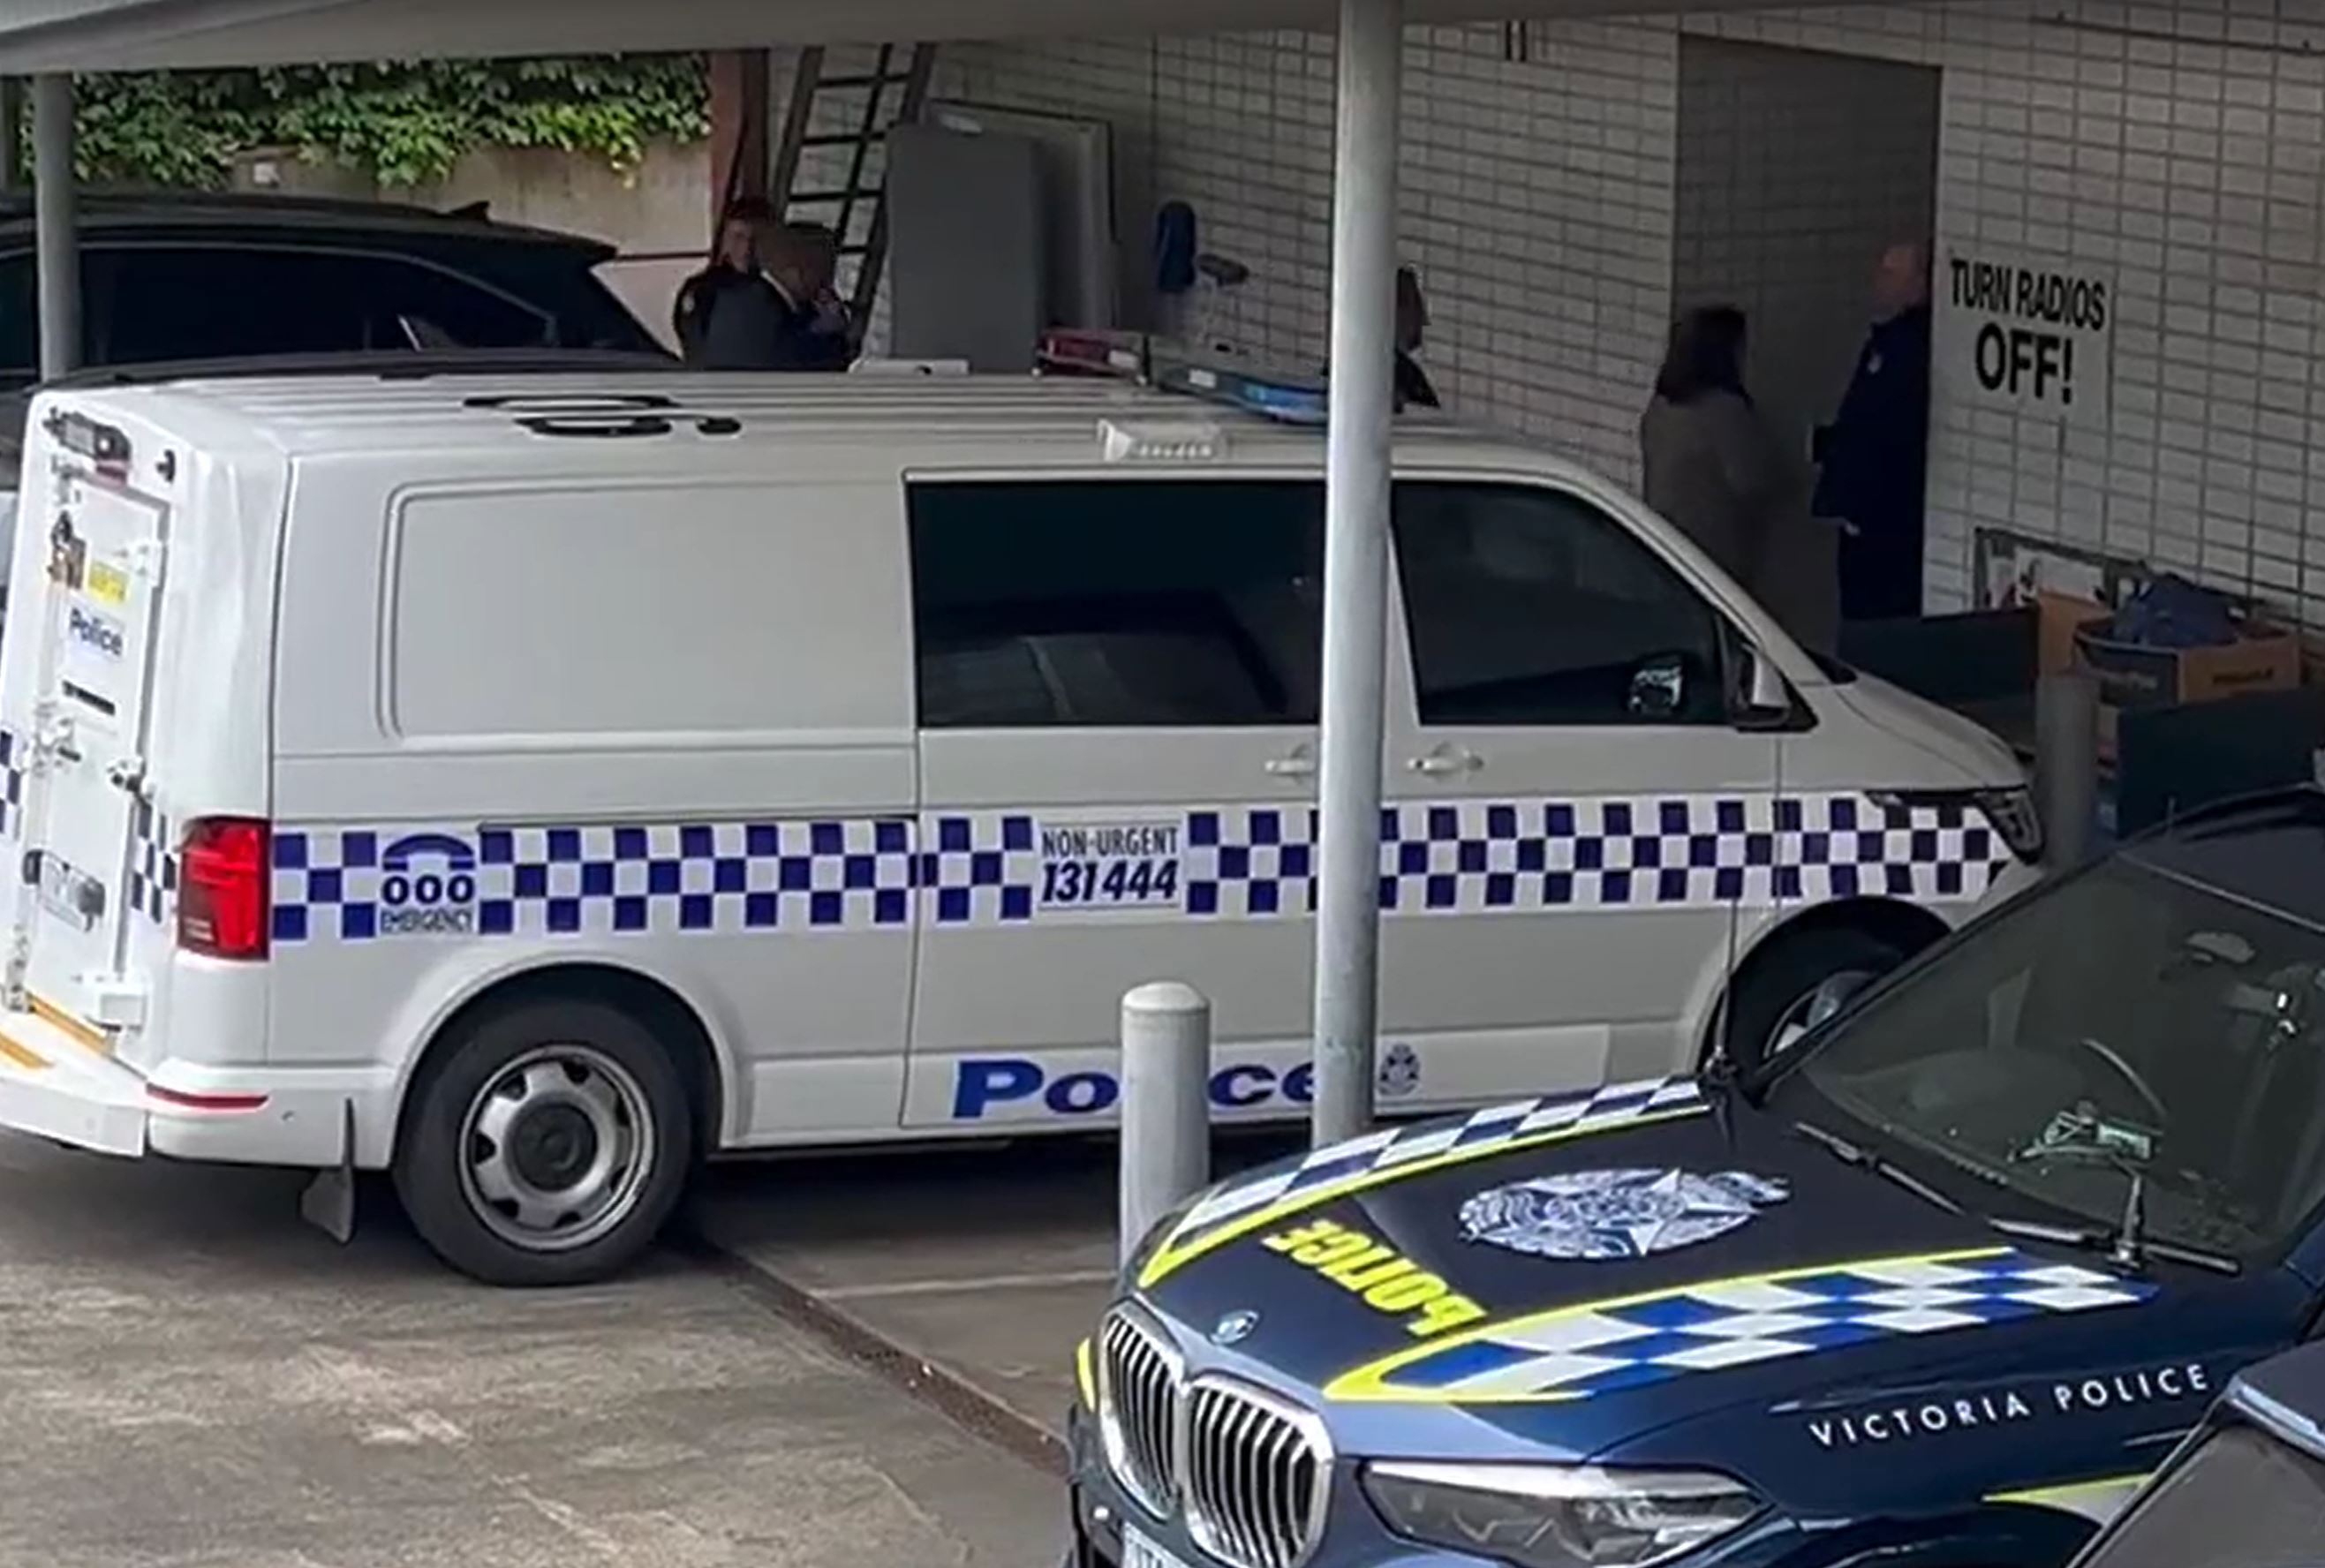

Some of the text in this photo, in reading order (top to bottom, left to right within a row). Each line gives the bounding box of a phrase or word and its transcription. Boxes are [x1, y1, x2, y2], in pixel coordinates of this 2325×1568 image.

[1951, 259, 2105, 330] TURN RADIOS
[1975, 322, 2072, 404] OFF!
[70, 607, 123, 656] Police
[1042, 827, 1178, 857] NON-URGENT
[382, 874, 474, 905] 000
[1809, 1364, 2208, 1446] VICTORIA POLICE
